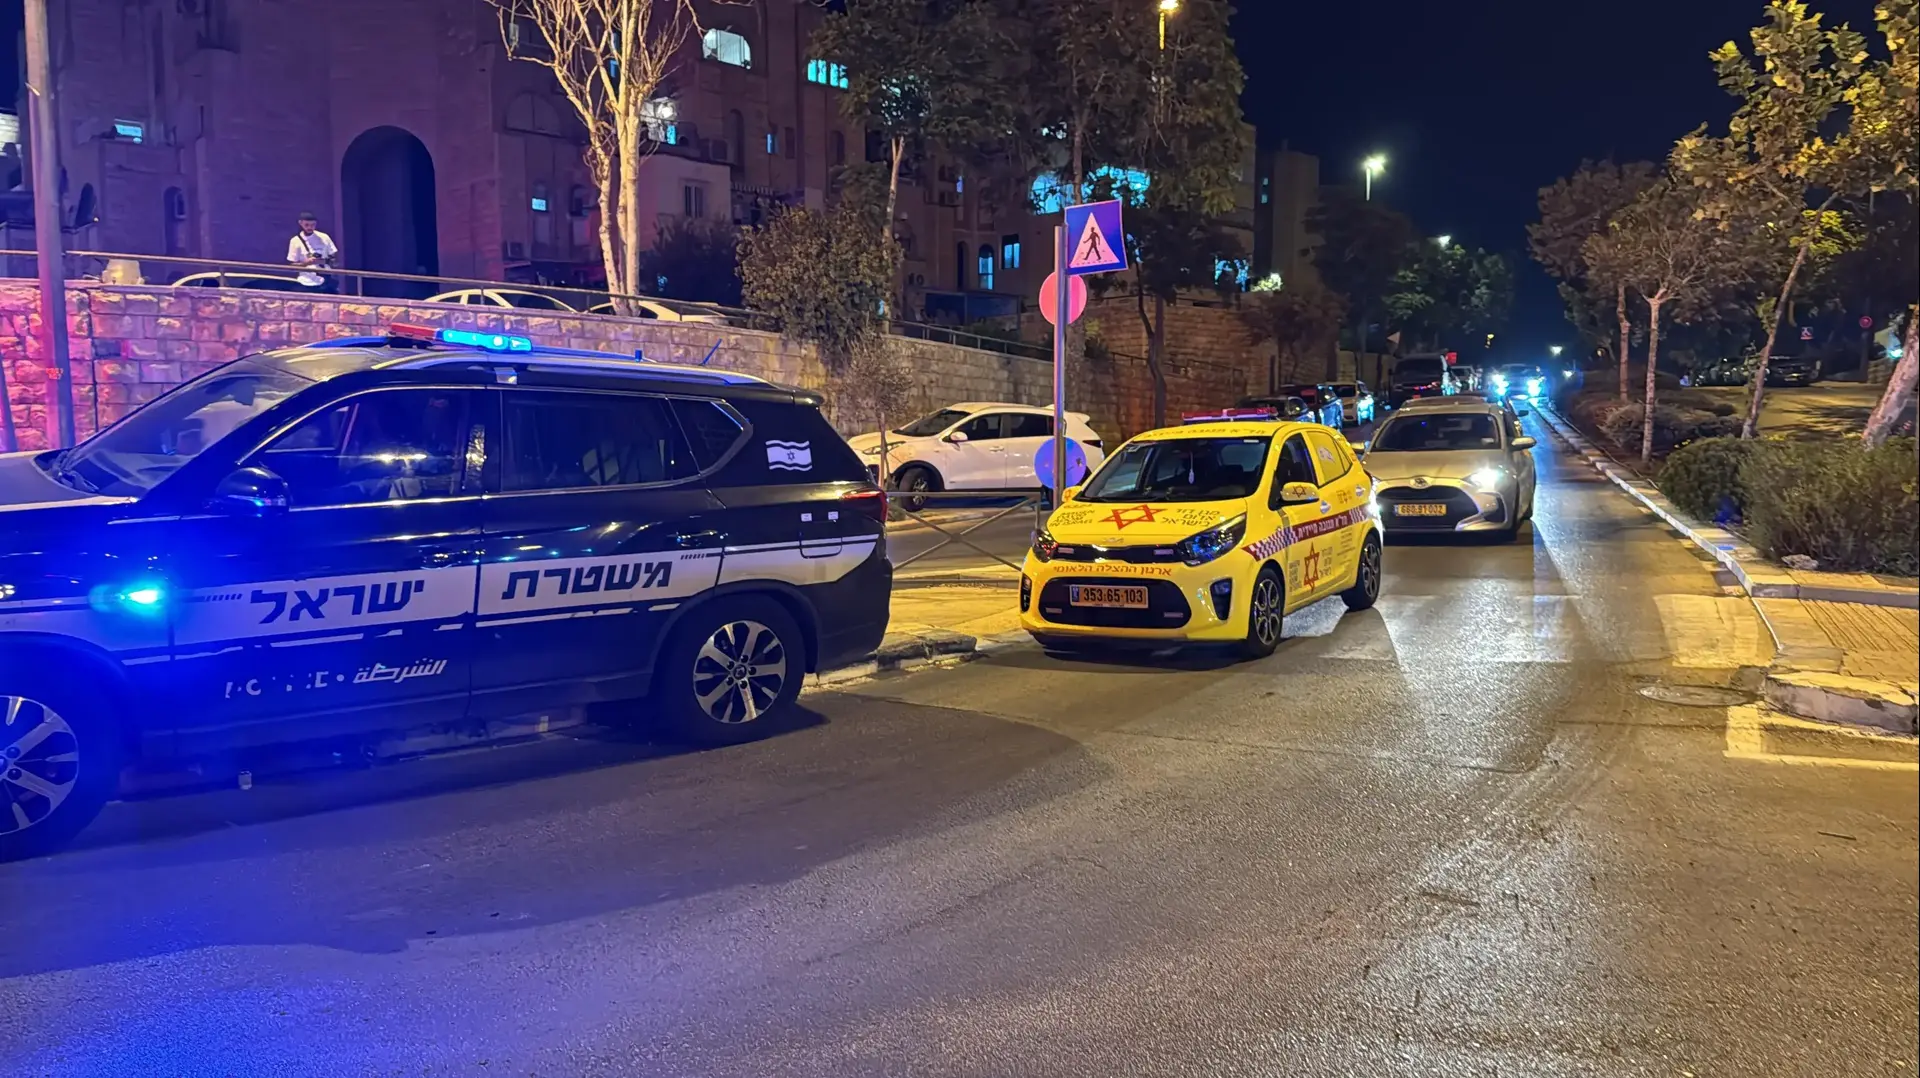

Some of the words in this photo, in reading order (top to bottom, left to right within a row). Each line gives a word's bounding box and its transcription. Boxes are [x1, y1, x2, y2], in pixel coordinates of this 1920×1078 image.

[1053, 564, 1093, 573] הלאומי
[1096, 564, 1137, 573] ההצלה
[1140, 565, 1172, 576] ארגון
[502, 561, 673, 600] משטרת
[250, 579, 424, 624] ישראל
[353, 658, 447, 684] الشرطة
